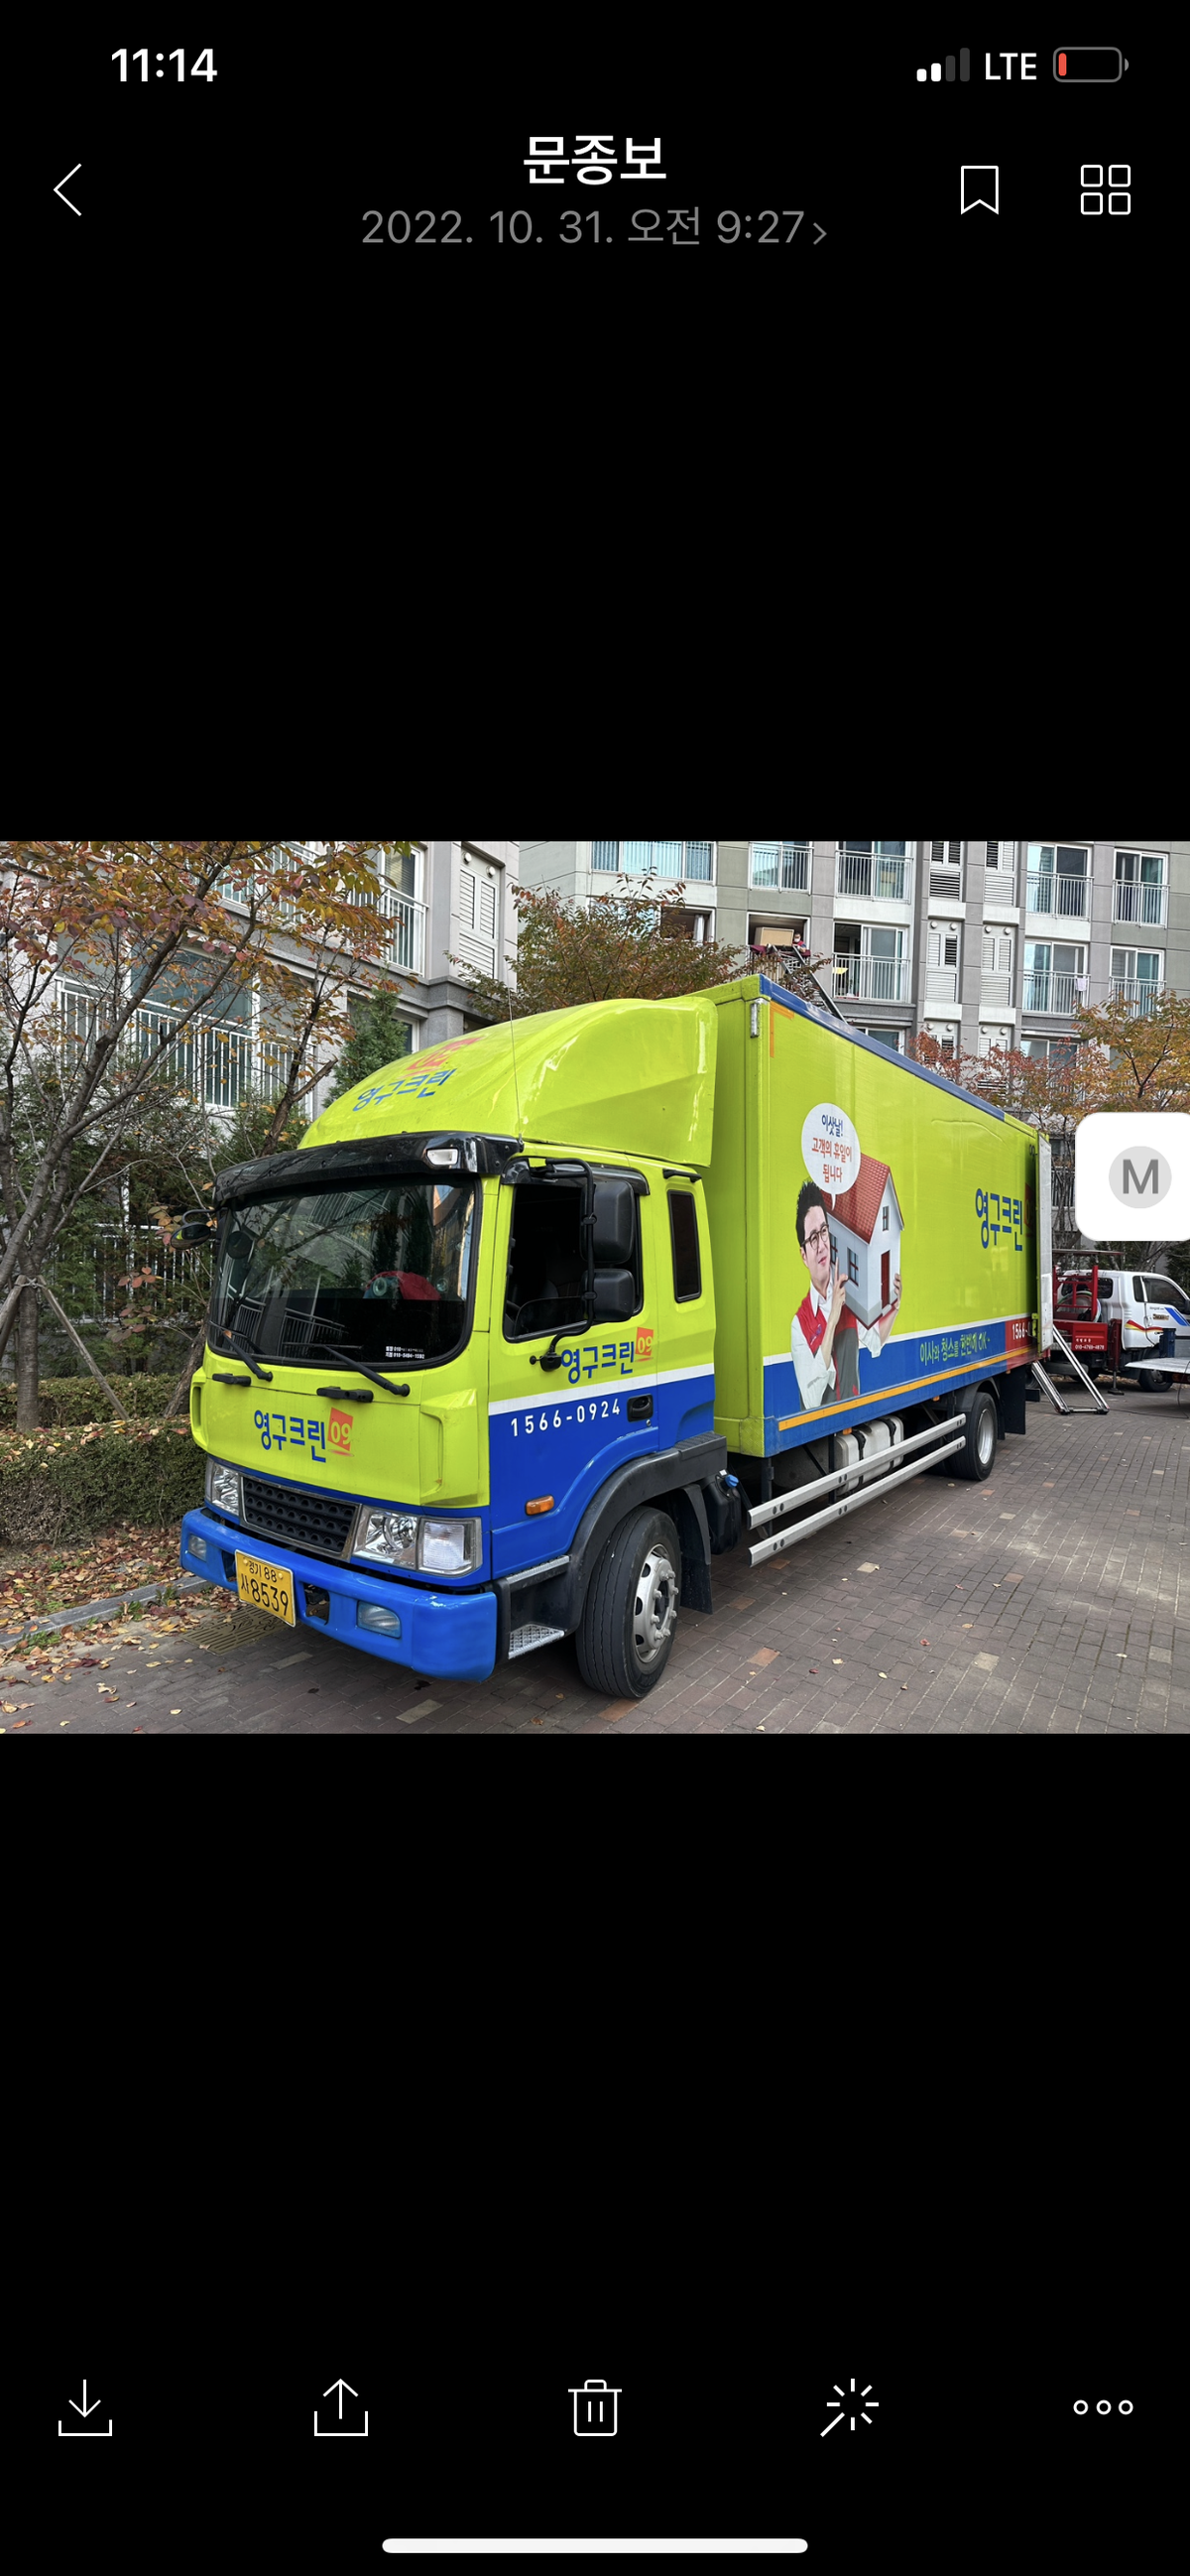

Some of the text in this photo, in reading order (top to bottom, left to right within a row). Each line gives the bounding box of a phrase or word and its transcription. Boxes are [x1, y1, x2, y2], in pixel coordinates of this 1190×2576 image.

[352, 1068, 457, 1111] 영구크린
[822, 1115, 844, 1138] 이삿날!
[812, 1138, 852, 1164] 고객의 휴일이
[823, 1164, 843, 1182] 됩니다
[976, 1188, 1023, 1251] 영구크린
[560, 1336, 653, 1384] 영구크린 09
[919, 1340, 940, 1367] 이사와
[941, 1337, 959, 1362] 청소를
[511, 1399, 621, 1437] 1566-0924
[254, 1410, 352, 1463] 영구크린 09
[249, 1560, 277, 1583] 경기 88
